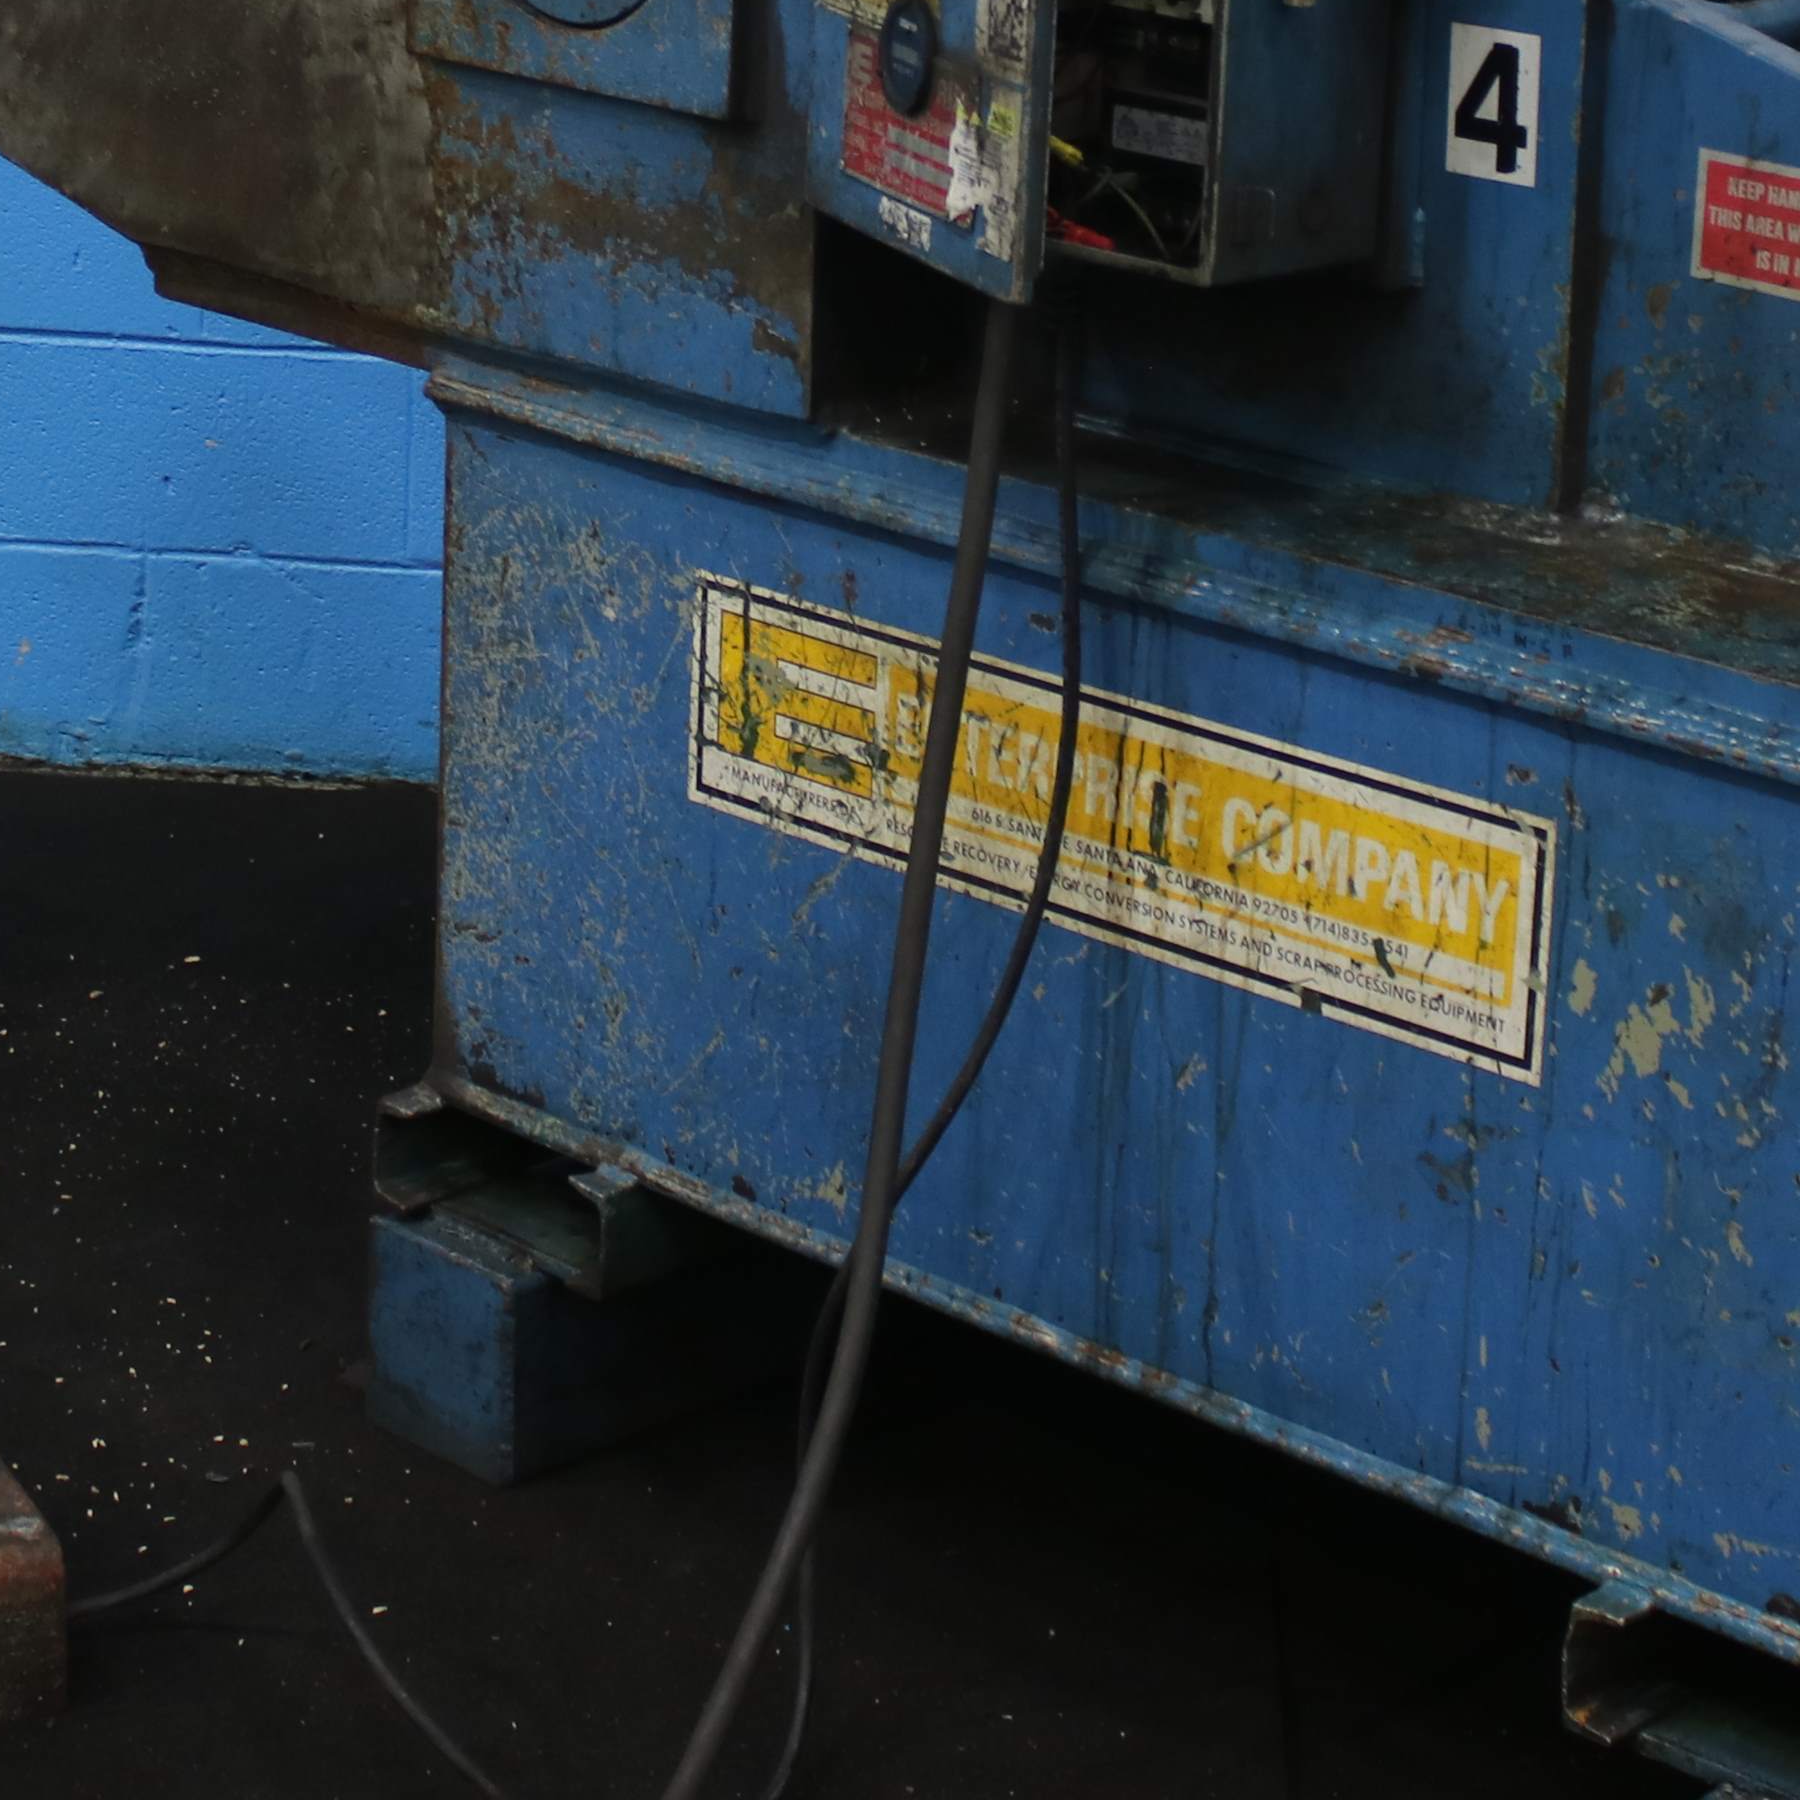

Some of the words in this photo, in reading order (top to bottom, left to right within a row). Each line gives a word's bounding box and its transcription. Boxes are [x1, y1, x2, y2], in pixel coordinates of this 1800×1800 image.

[1455, 43, 1527, 173] 4
[1708, 206, 1743, 231] THIS
[1745, 214, 1785, 242] AREA
[1727, 177, 1765, 202] KEEP
[1756, 249, 1772, 271] IS
[1773, 253, 1790, 275] IN
[971, 807, 992, 824] 616
[1164, 870, 1248, 909] CALIFORNIA
[1253, 898, 1299, 924] 92705
[1220, 796, 1510, 945] COMPANY
[952, 837, 1020, 874] RECOVERY
[1084, 883, 1176, 927] CONVERSION
[1178, 914, 1237, 946] SYSTEMS
[1240, 935, 1273, 957] AND
[1420, 993, 1506, 1033] EQUIPMENT
